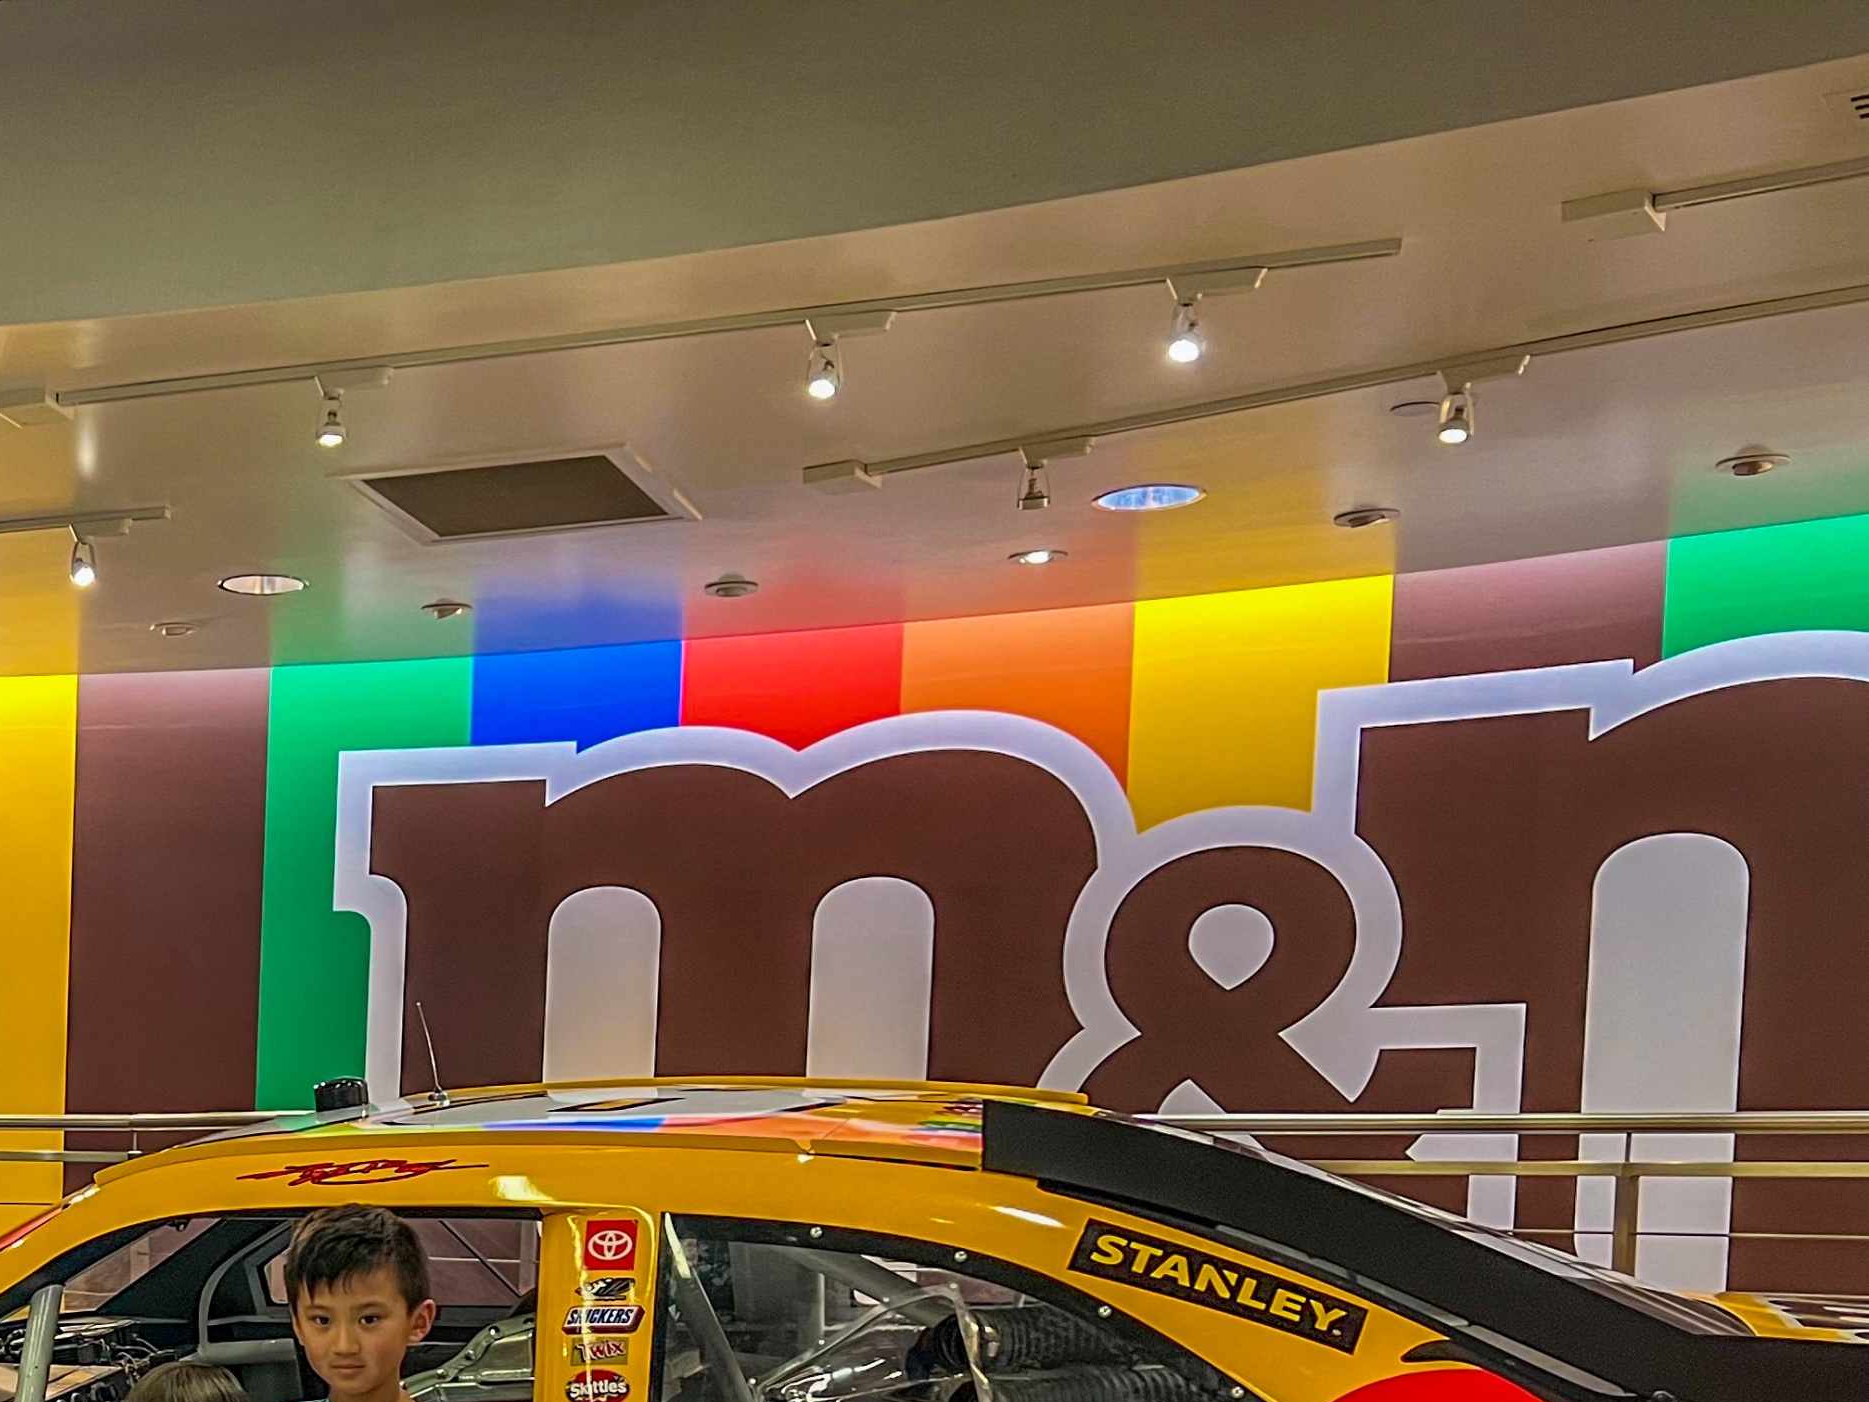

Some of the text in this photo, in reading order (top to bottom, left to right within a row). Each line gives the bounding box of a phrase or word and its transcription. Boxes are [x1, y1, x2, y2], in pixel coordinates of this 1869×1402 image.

[1090, 1234, 1347, 1331] STANLEY
[566, 1307, 634, 1326] SNICKERS
[569, 1379, 628, 1399] Skittles
